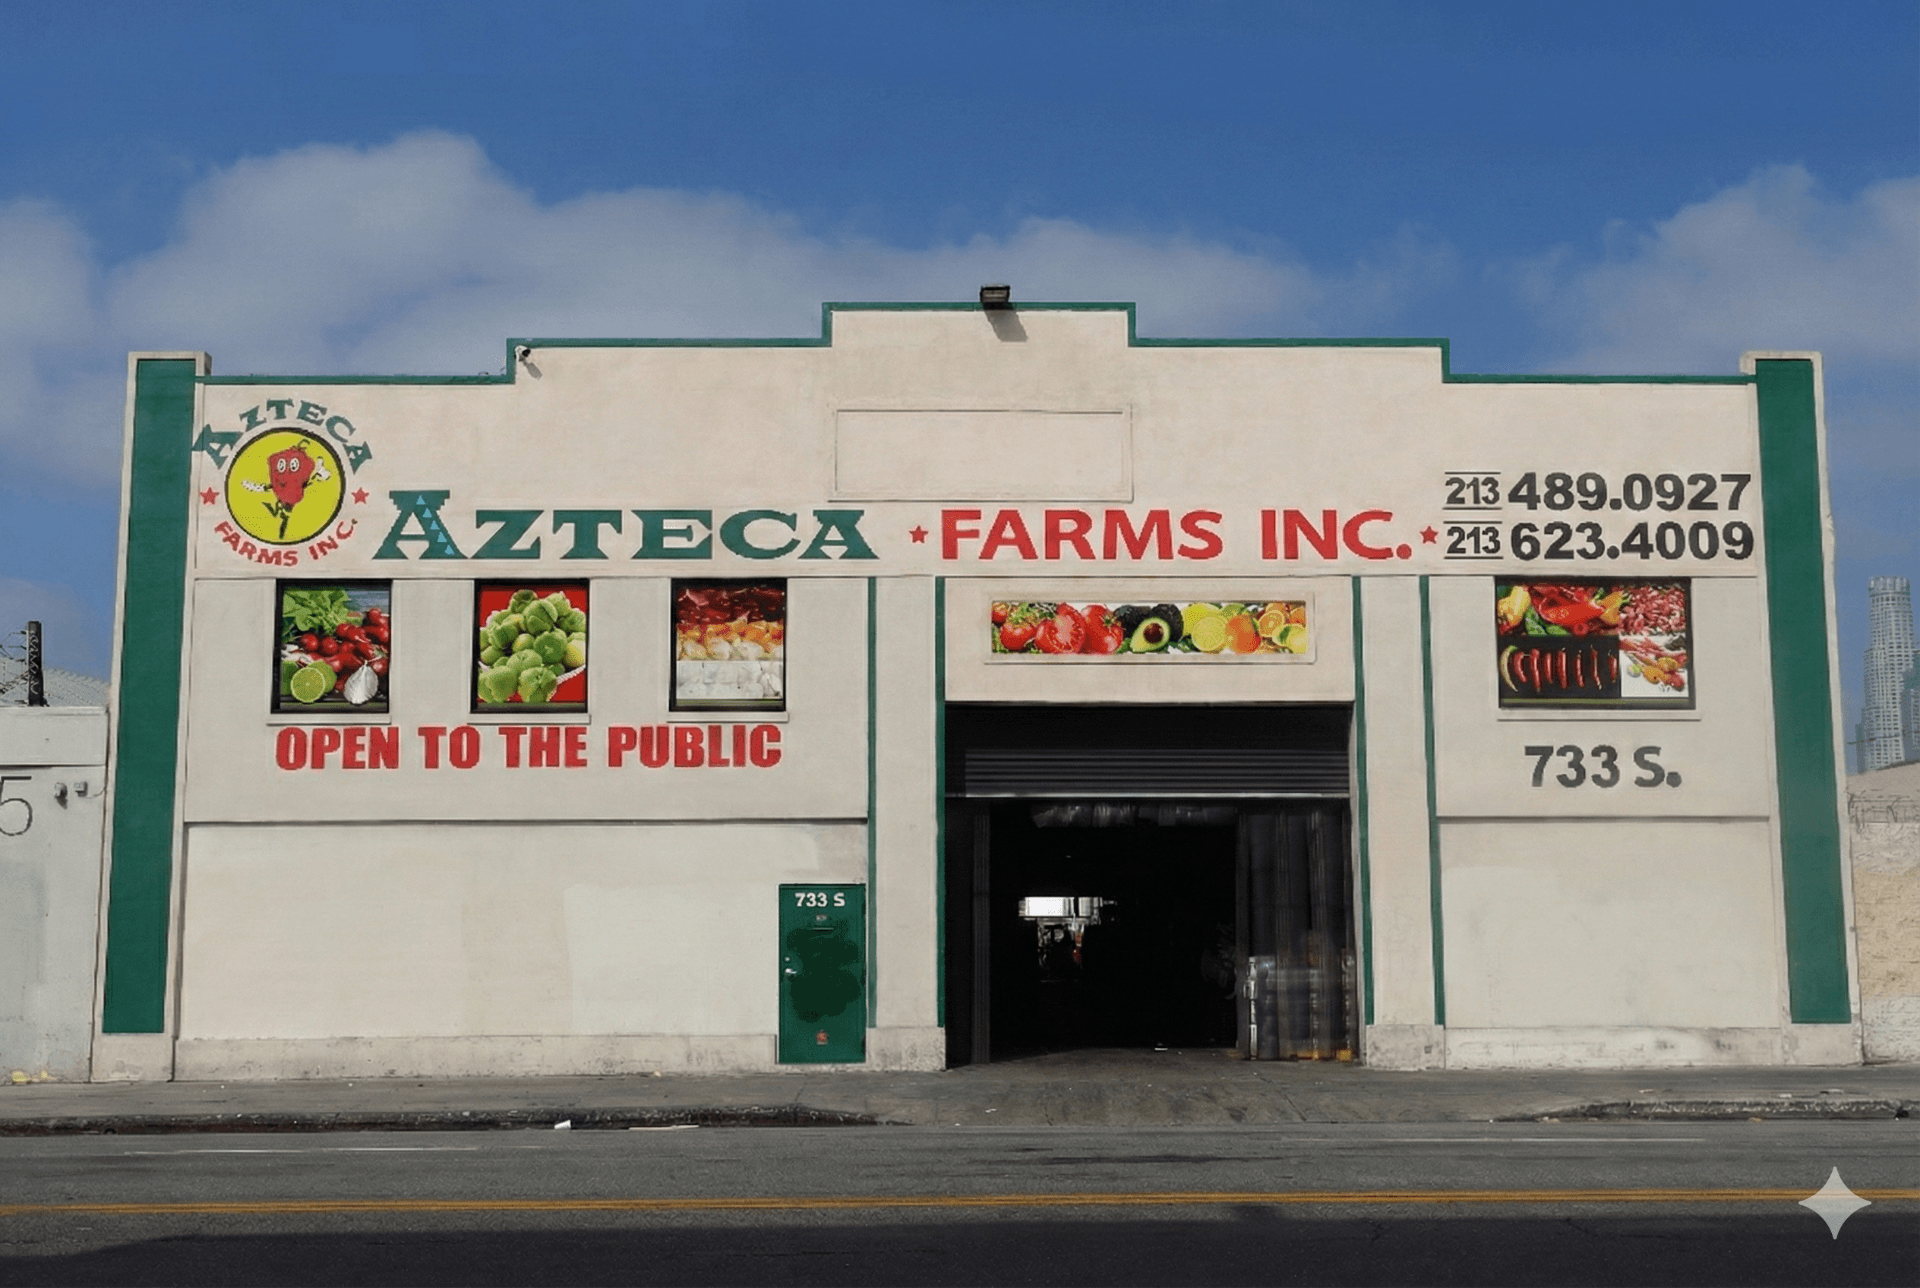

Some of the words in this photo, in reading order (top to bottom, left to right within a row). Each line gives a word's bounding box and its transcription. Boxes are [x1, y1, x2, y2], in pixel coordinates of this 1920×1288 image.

[191, 399, 373, 475] AZTECA
[1444, 477, 1500, 505] 213
[1508, 472, 1752, 511] 489.0927
[213, 520, 299, 567] FARMS
[372, 489, 880, 560] AZTECA
[941, 509, 1224, 559] FARMS
[1261, 509, 1413, 560] INC.
[1446, 526, 1501, 555] 213
[1511, 521, 1755, 561] 623.4009
[275, 726, 400, 771] OPEN
[418, 726, 481, 770] TO
[504, 726, 588, 769] THE
[608, 724, 783, 769] PUBLIC
[1523, 745, 1621, 789] 733
[1633, 746, 1683, 789] S.
[795, 892, 828, 907] 733
[833, 892, 845, 907] S
